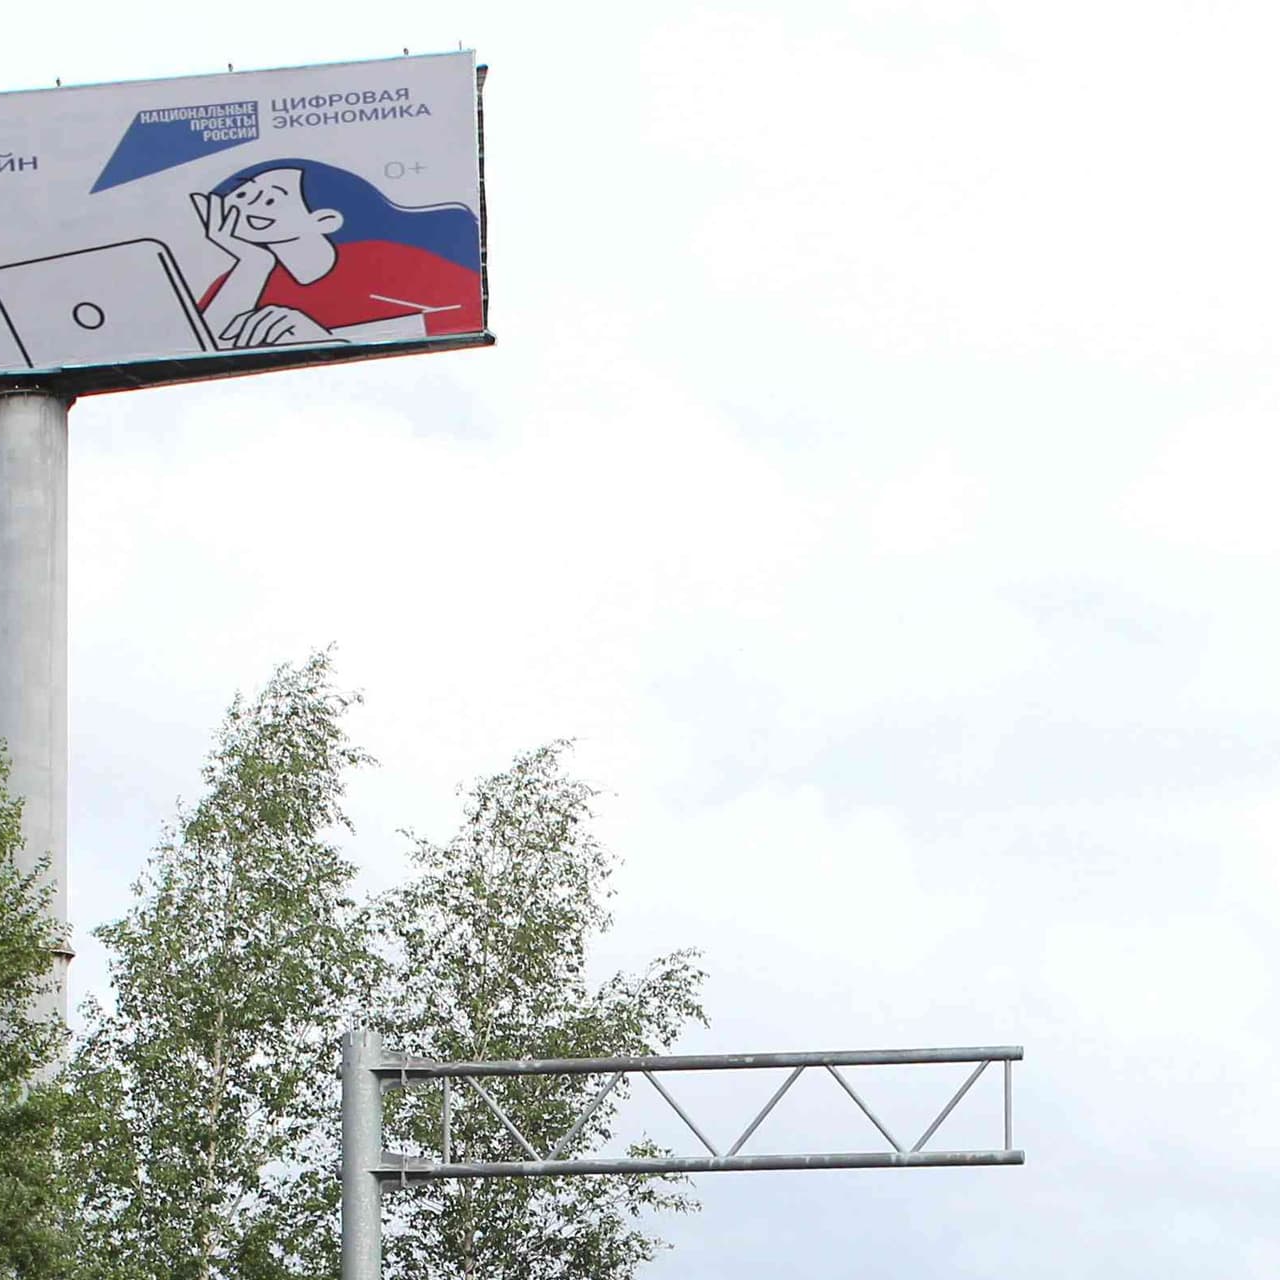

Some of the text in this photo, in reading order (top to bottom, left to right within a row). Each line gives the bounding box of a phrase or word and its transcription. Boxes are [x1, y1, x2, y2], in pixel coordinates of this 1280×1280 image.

[271, 88, 410, 114] ЦИФРОВАЯ
[140, 102, 256, 124] НАЦИОНАЛЬНЫЕ
[190, 115, 257, 131] ПРОЕКТЫ
[272, 103, 432, 129] ЭКОНОМИКА
[203, 127, 258, 142] РОССИИ
